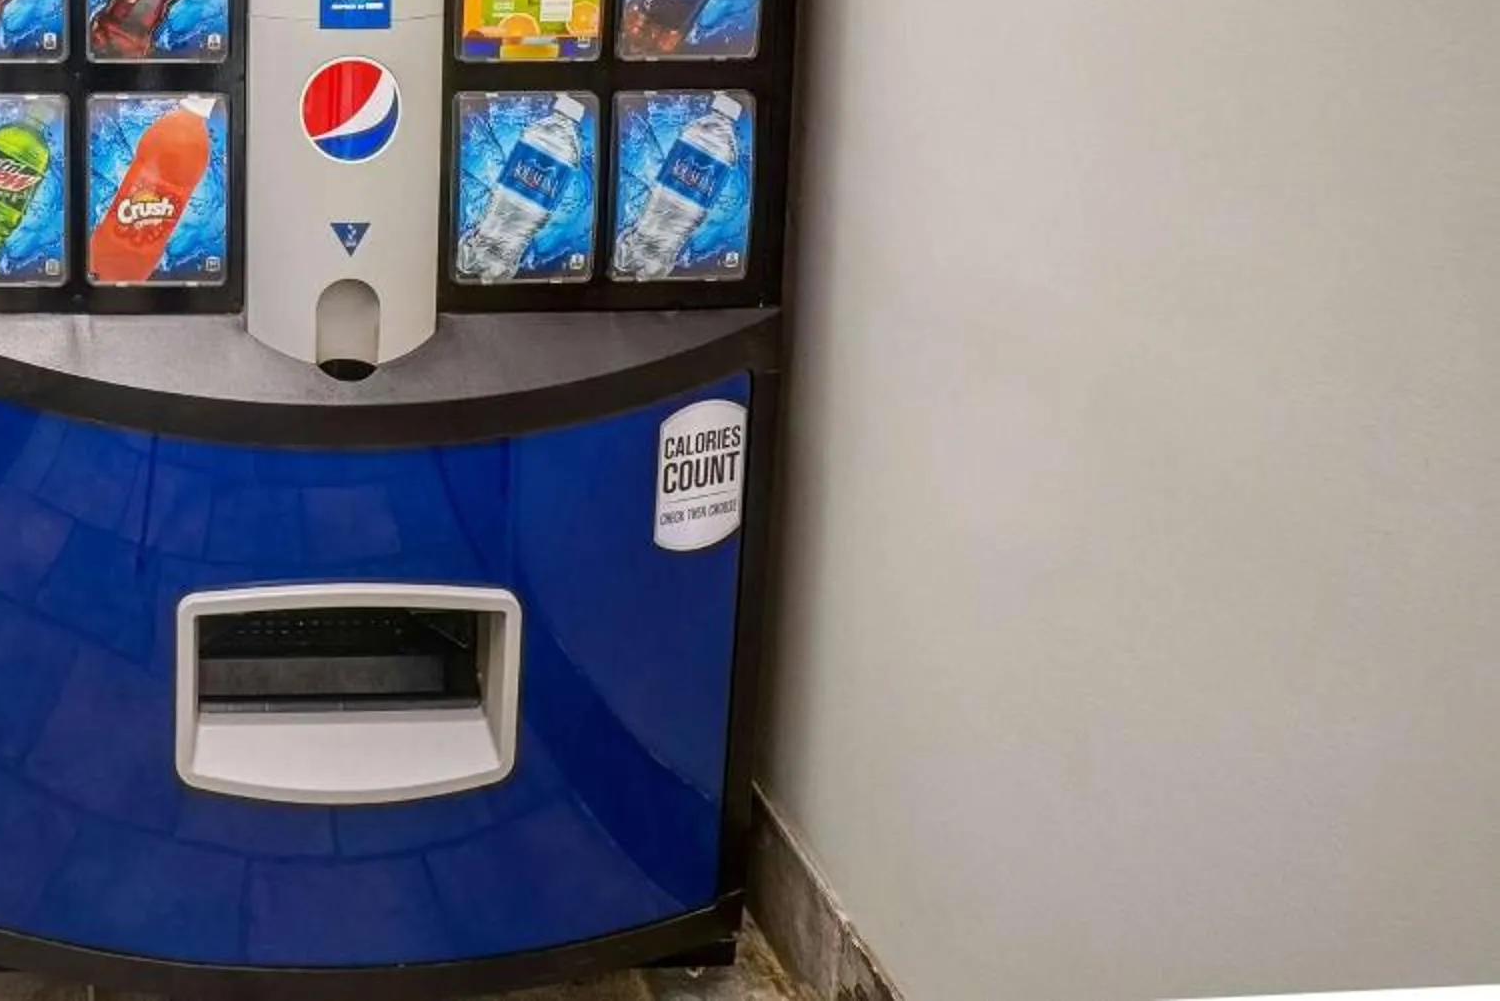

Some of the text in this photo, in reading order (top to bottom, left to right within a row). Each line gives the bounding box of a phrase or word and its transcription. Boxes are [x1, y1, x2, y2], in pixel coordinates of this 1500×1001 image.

[117, 197, 174, 223] Crush
[664, 425, 741, 460] CALORIES
[663, 451, 741, 494] COUNT
